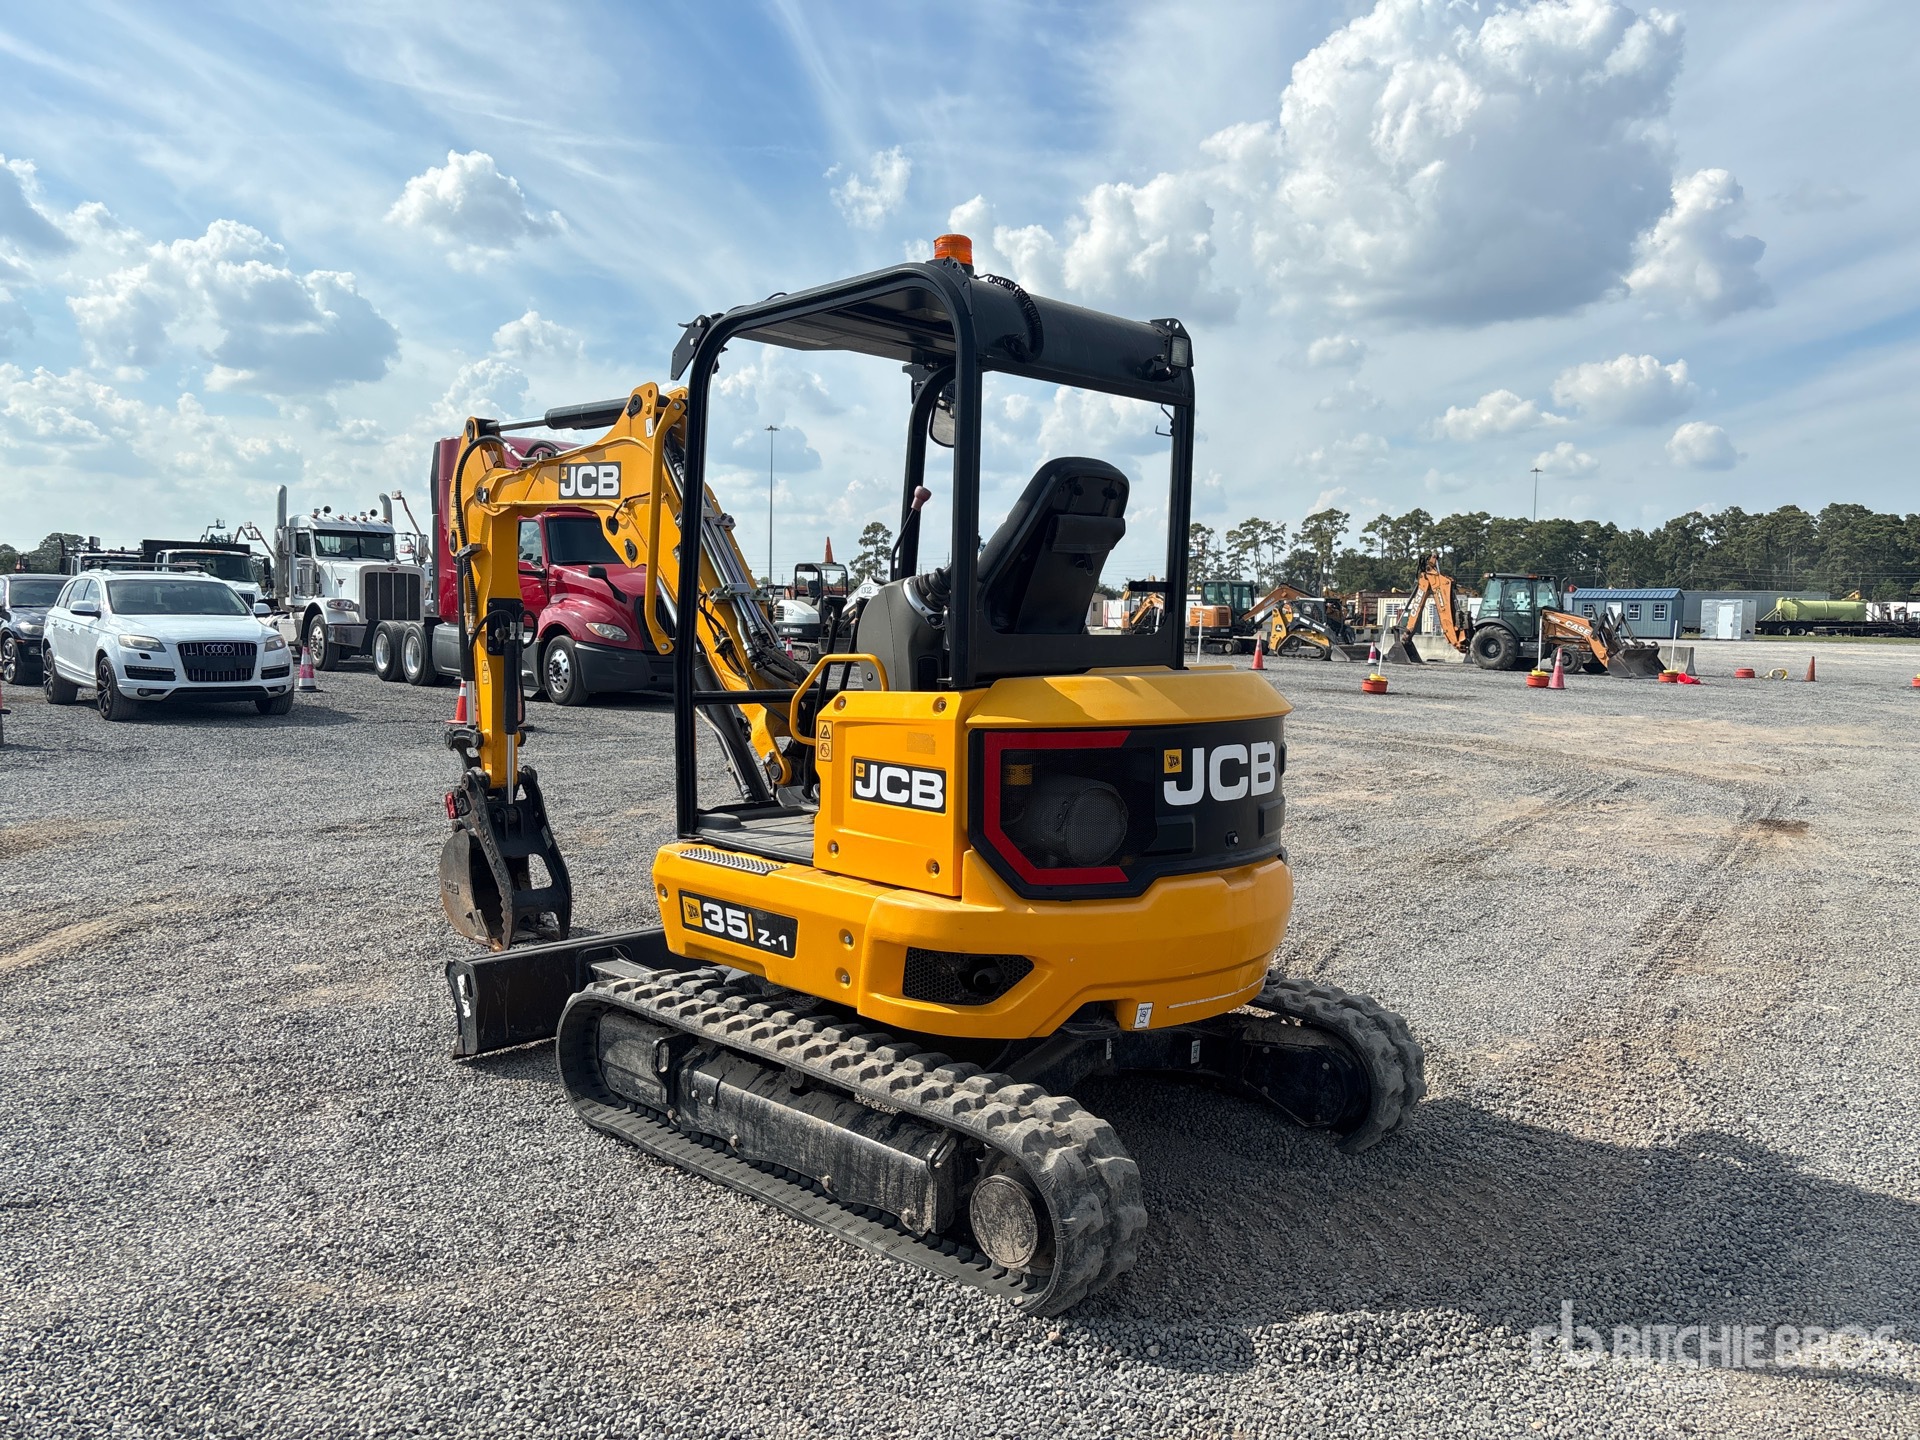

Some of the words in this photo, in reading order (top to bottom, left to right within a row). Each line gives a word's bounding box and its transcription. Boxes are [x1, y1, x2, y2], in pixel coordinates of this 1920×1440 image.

[560, 465, 619, 496] JCB
[1410, 588, 1426, 618] CASE
[1564, 620, 1592, 637] CASE
[854, 764, 945, 809] JCB
[1163, 741, 1276, 806] JCB
[703, 902, 749, 940] 35
[758, 928, 788, 952] Z-1
